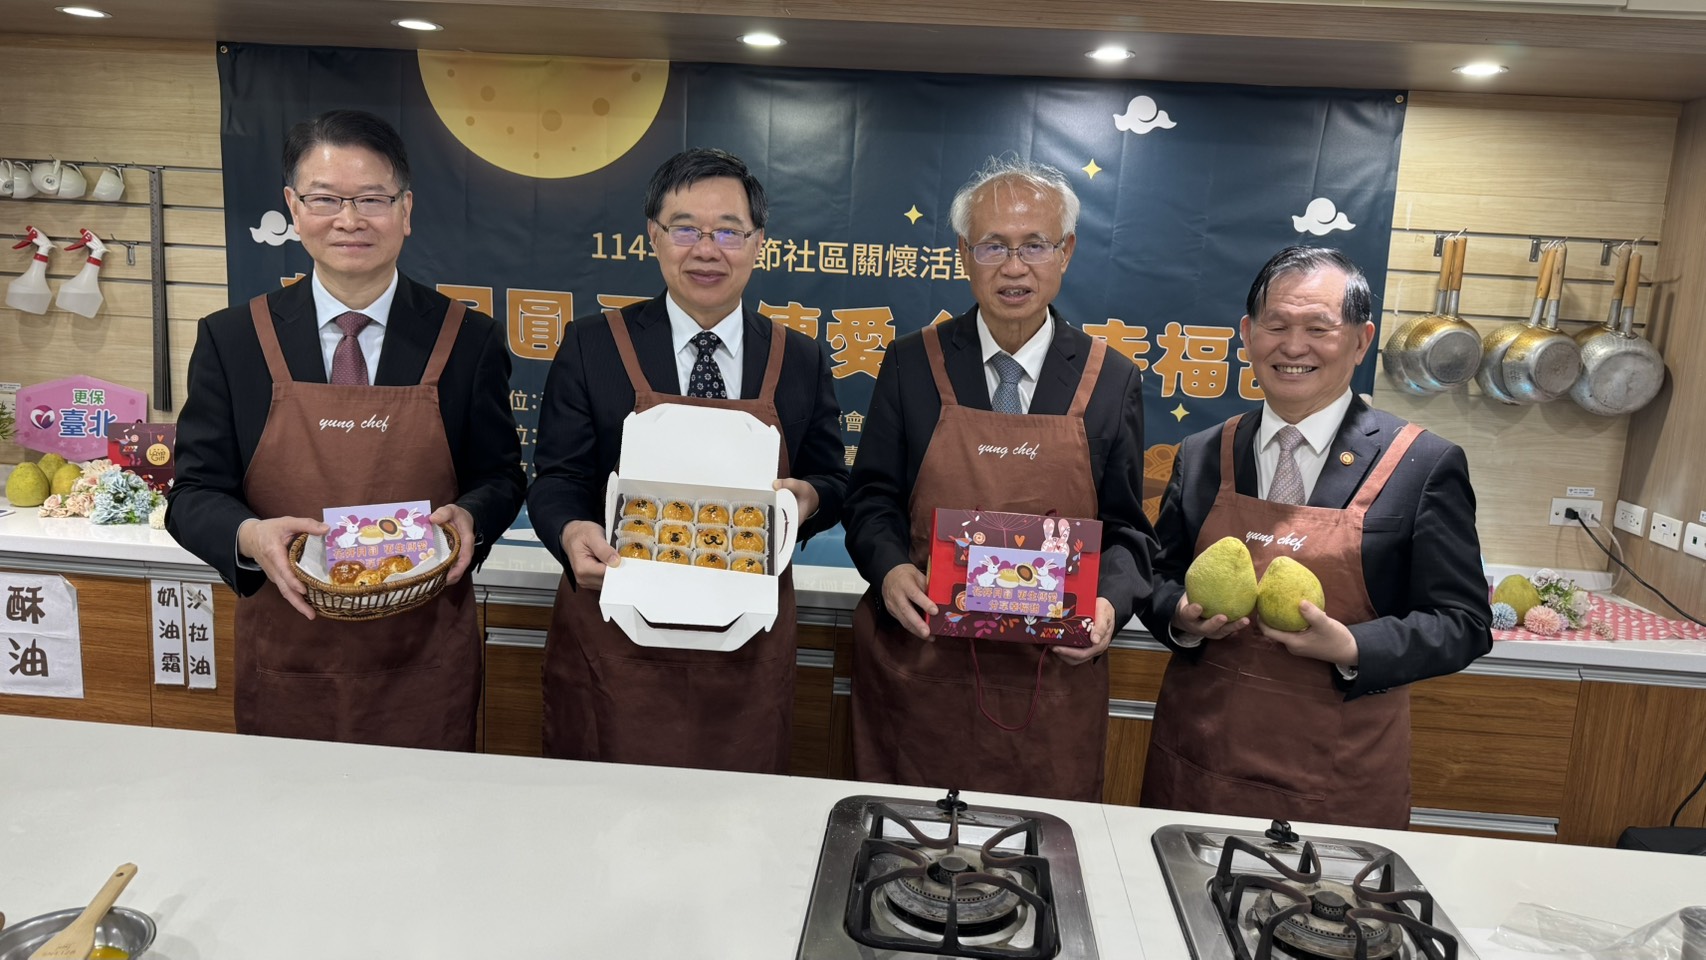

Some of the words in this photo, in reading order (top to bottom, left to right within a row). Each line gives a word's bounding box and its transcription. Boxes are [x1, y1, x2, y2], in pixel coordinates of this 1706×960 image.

[592, 232, 657, 261] 114
[1082, 318, 1266, 401] 幸福
[73, 388, 105, 405] 更保
[59, 408, 117, 437] 臺北
[319, 416, 355, 433] yung
[361, 414, 390, 432] chef
[839, 410, 865, 432] 會
[978, 444, 1009, 458] yung
[1013, 442, 1040, 460] chef
[1246, 530, 1275, 547] yung
[1277, 530, 1308, 552] chef
[6, 585, 49, 677] 酥油
[157, 586, 181, 673] 奶油霜
[186, 589, 211, 675] 沙拉油
